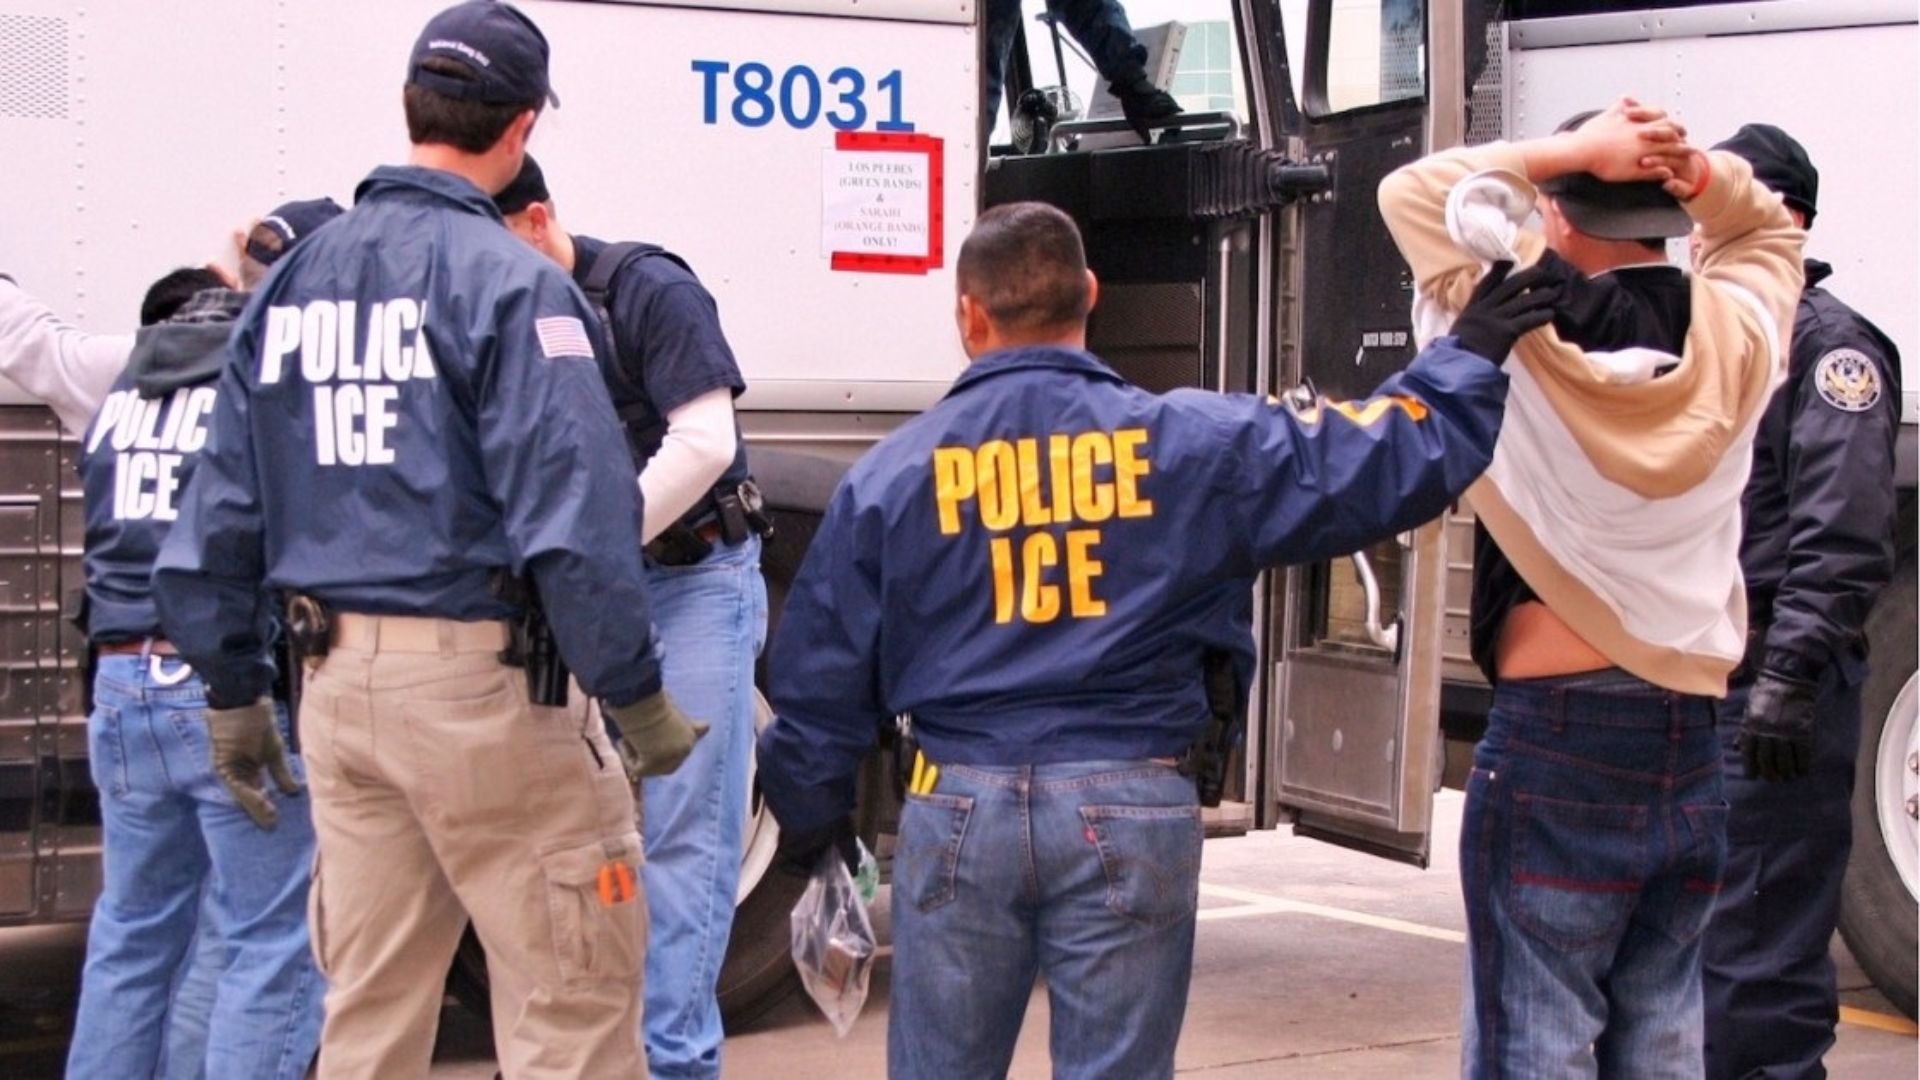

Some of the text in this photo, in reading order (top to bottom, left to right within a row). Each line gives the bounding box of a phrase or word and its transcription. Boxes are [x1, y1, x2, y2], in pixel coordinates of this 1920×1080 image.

[691, 60, 915, 132] T8031
[849, 162, 870, 173] LOS
[876, 193, 884, 203] &
[87, 386, 217, 453] POLIC
[314, 384, 399, 466] ICE
[113, 452, 182, 521] ICE
[933, 428, 1153, 535] POLICE
[990, 529, 1107, 624] ICE
